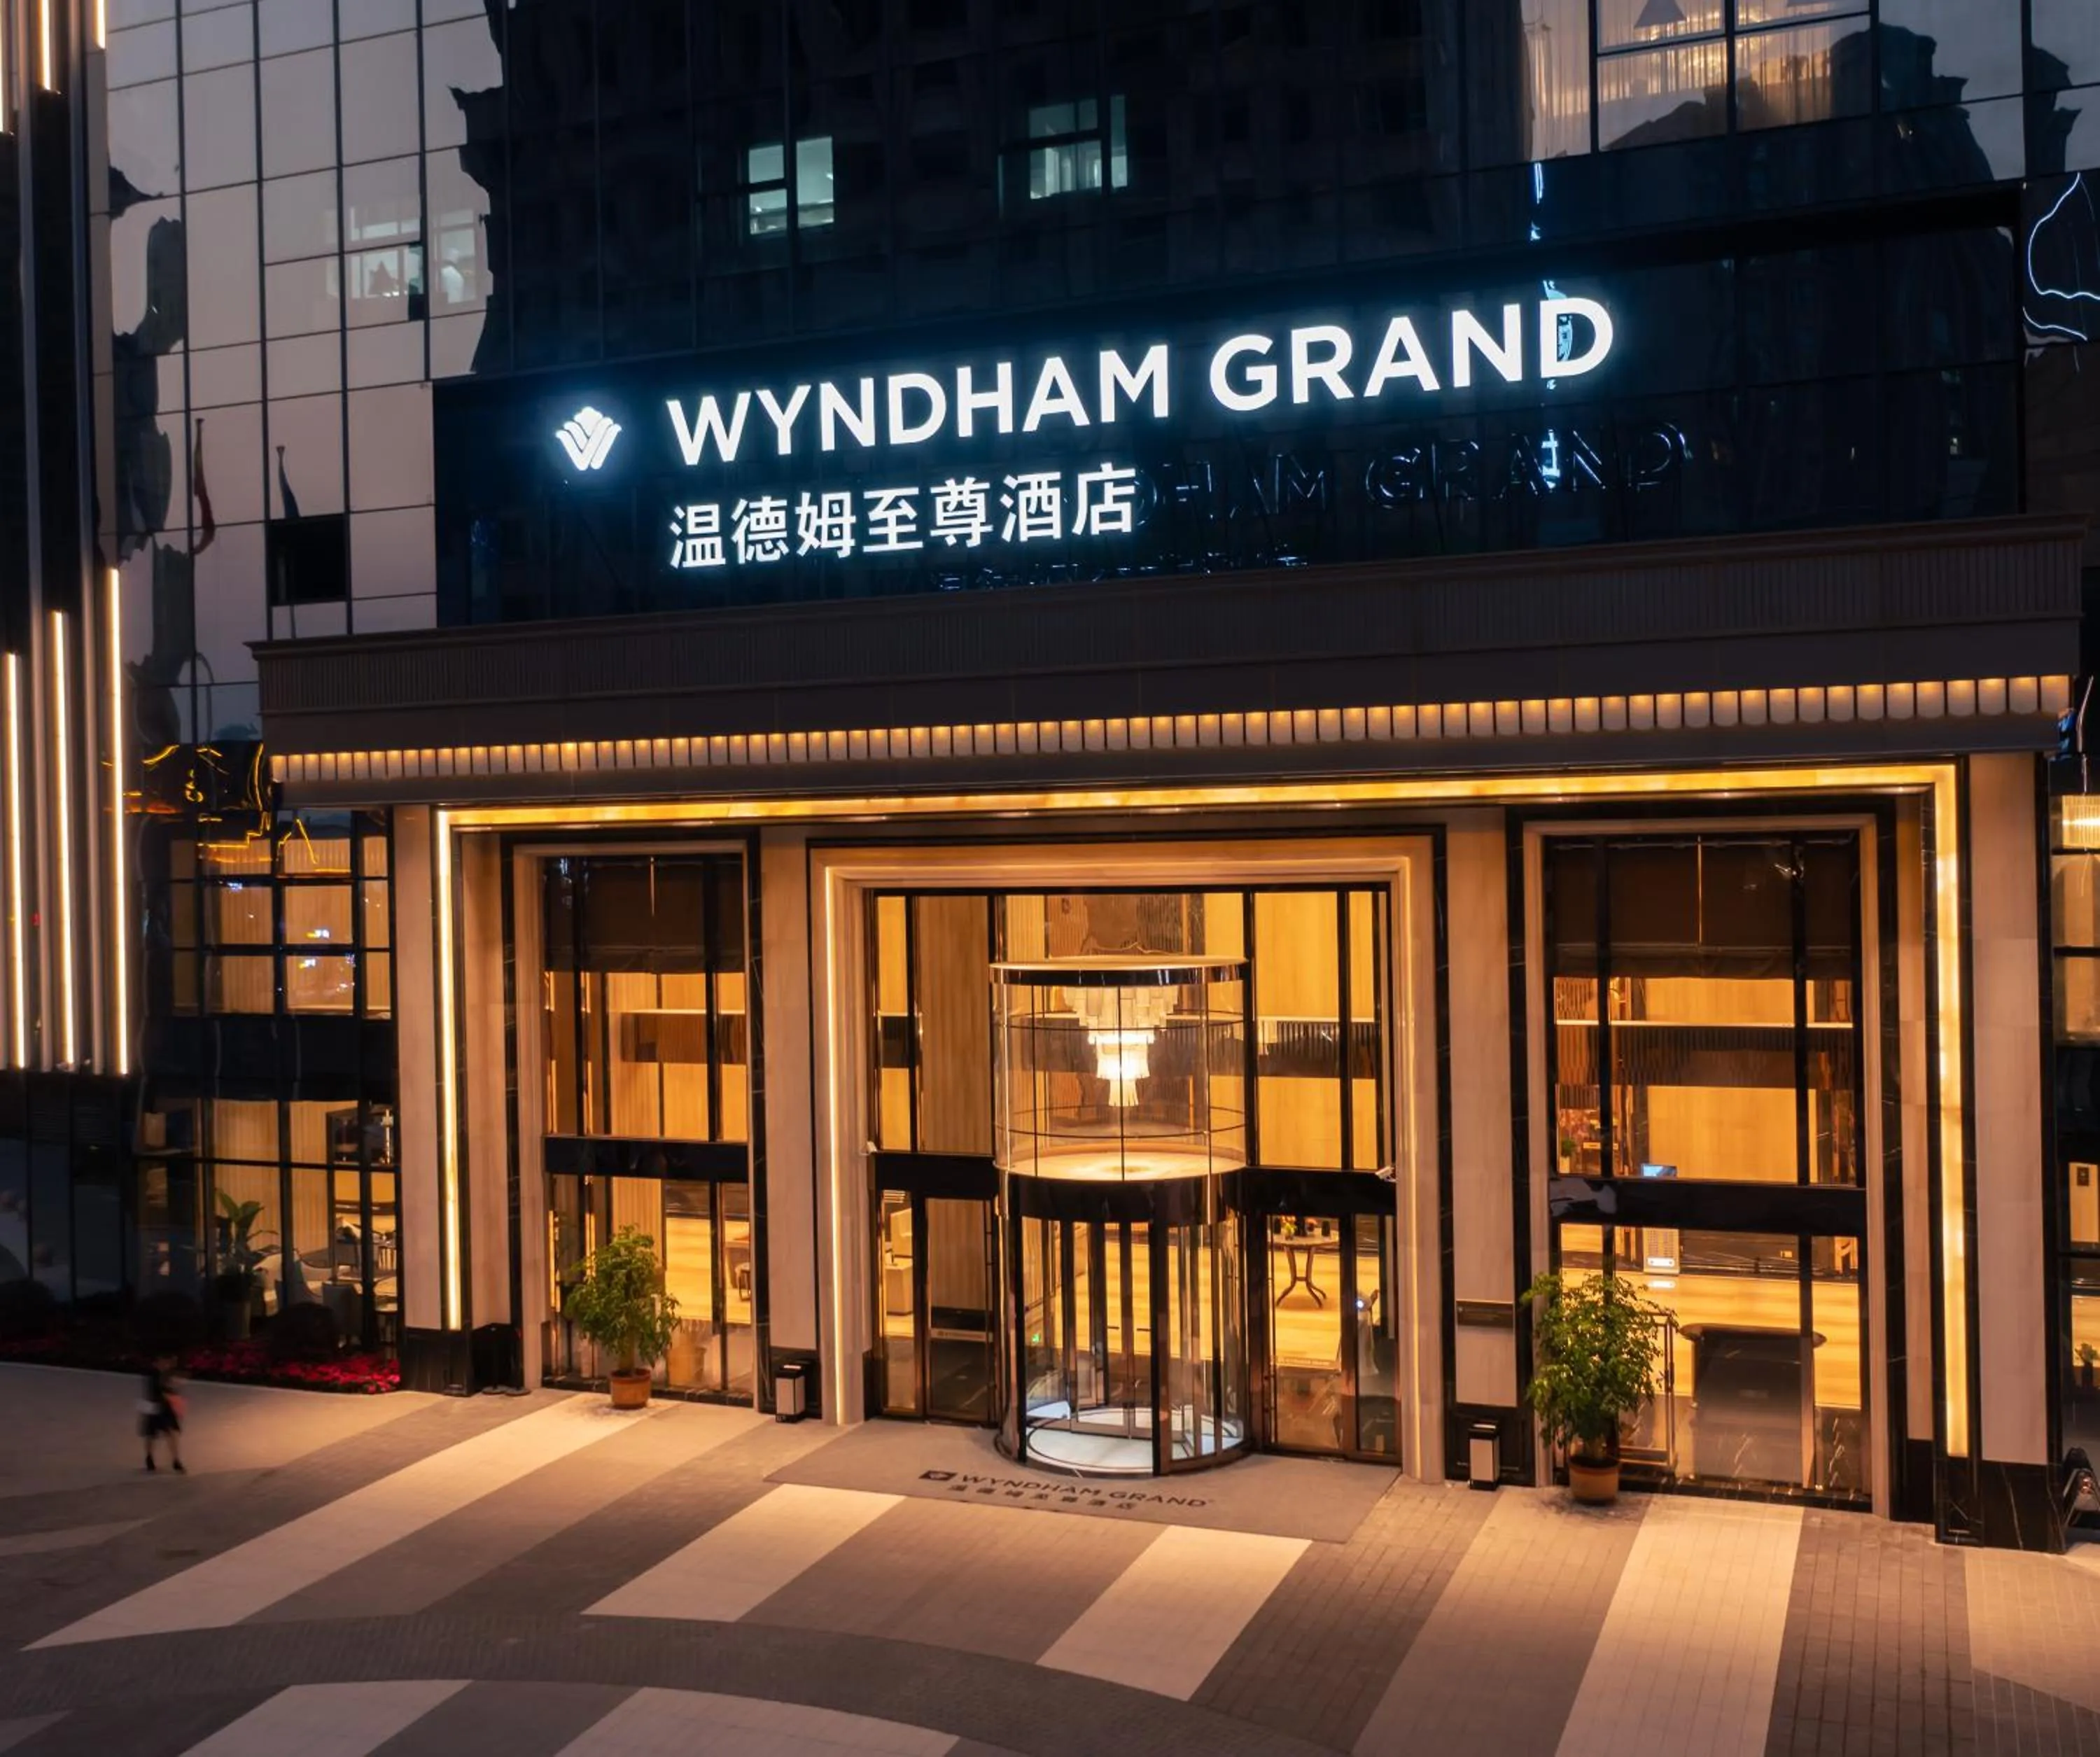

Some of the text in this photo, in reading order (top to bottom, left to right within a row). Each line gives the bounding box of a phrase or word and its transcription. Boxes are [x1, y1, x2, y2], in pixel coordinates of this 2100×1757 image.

[667, 298, 1614, 465] WYNDHAM GRAND
[669, 463, 1136, 568] 温德姆至尊酒店
[962, 1474, 1101, 1496] WYNDHAM
[1109, 1491, 1207, 1508] GRAND
